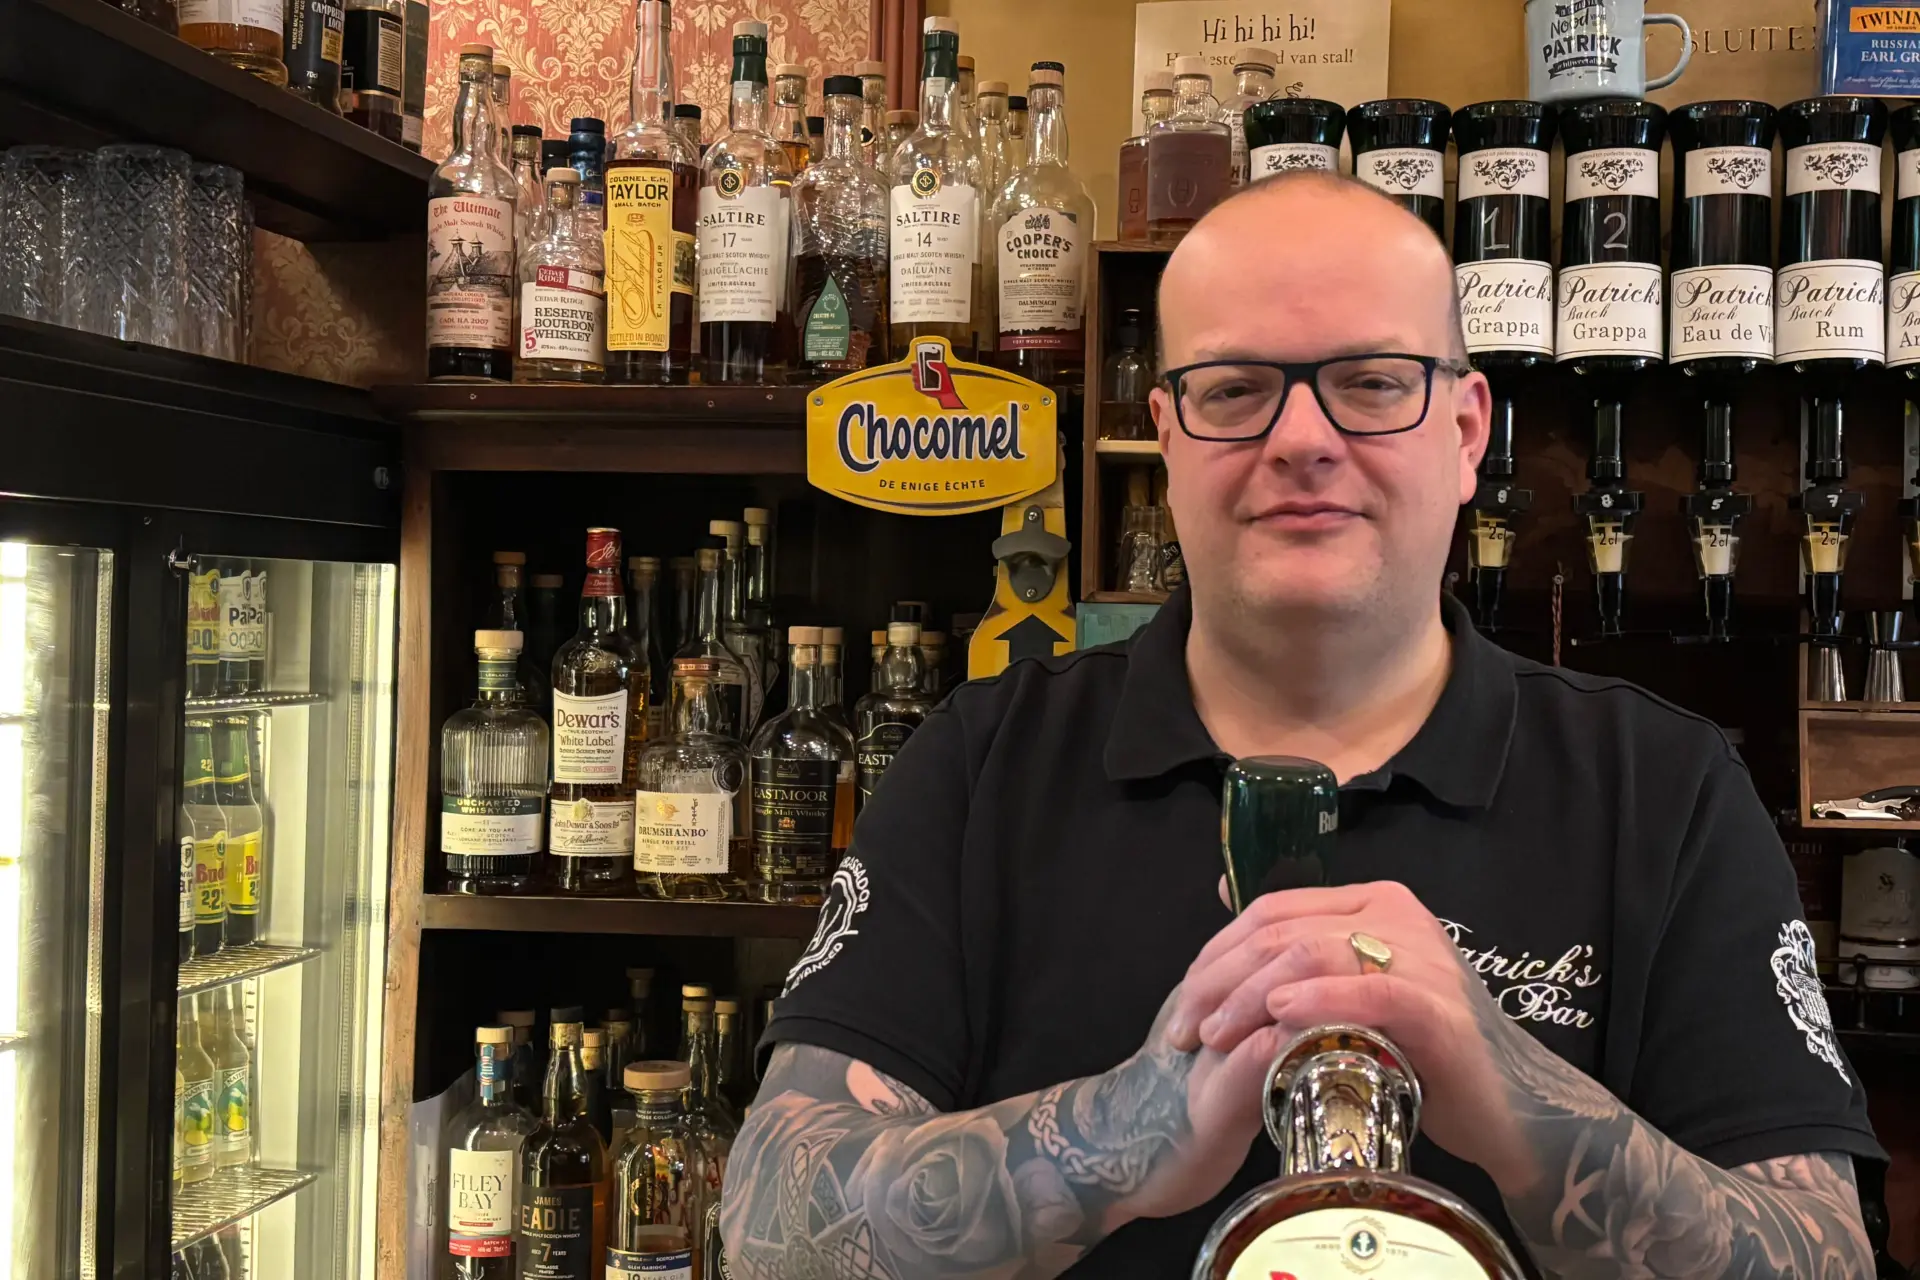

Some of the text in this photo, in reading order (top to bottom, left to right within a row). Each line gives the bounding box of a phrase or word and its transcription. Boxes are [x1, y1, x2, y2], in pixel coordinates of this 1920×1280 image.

[1203, 14, 1316, 43] Hi hi hi hi!
[1542, 34, 1622, 63] PATRICK
[1290, 54, 1316, 64] van
[1322, 49, 1354, 63] stal!
[1861, 51, 1897, 62] EARL
[609, 183, 669, 201] TAYLOR
[433, 201, 502, 219] The Ultimate
[460, 218, 484, 228] Scotch
[703, 211, 766, 227] SALTIRE
[896, 211, 961, 226] SALTIRE
[1484, 207, 1510, 250] 1
[1603, 212, 1629, 249] 2
[722, 232, 737, 248] 17
[917, 232, 932, 247] 14
[1006, 233, 1075, 253] COOPER'S
[1017, 249, 1060, 259] CHOICE
[538, 268, 565, 283] CEDAR RIDGE
[701, 266, 769, 276] CRAIGELLACHIE
[901, 266, 953, 276] DAILUAINE
[534, 295, 585, 305] CEDAR RIDGE
[534, 307, 594, 322] RESERVE
[1566, 304, 1611, 322] Batch
[1681, 305, 1738, 323] Batch
[1788, 302, 1835, 322] Batch
[534, 318, 595, 333] BOURBON
[1468, 318, 1540, 337] Grappa
[1573, 322, 1647, 342] Grappa
[1682, 325, 1721, 343] Eau
[1731, 323, 1753, 340] de
[1816, 321, 1864, 338] Rum
[524, 329, 537, 350] 5
[533, 329, 592, 342] WHISKEY
[609, 333, 635, 343] BOTTLED
[636, 333, 644, 342] IN
[838, 402, 1027, 474] Chocomel
[879, 479, 895, 489] DE
[901, 479, 939, 491] ENIGE
[1601, 494, 1614, 508] 8
[1711, 498, 1724, 510] 5
[1826, 495, 1839, 507] 7
[557, 709, 620, 728] Dewar's
[754, 787, 828, 802] EASTMOOR
[457, 799, 520, 807] UNCHARTED
[774, 808, 794, 816] Malt
[795, 809, 828, 817] Whisky
[566, 820, 588, 829] Dewar
[594, 820, 612, 829] Sons
[638, 826, 706, 837] DRUMSHANBO
[1499, 982, 1595, 1029] Bar
[452, 1173, 508, 1192] FILEY
[458, 1192, 498, 1210] BAY
[534, 1196, 562, 1206] JAMES
[521, 1205, 581, 1231] EADIE
[541, 1243, 552, 1262] 7
